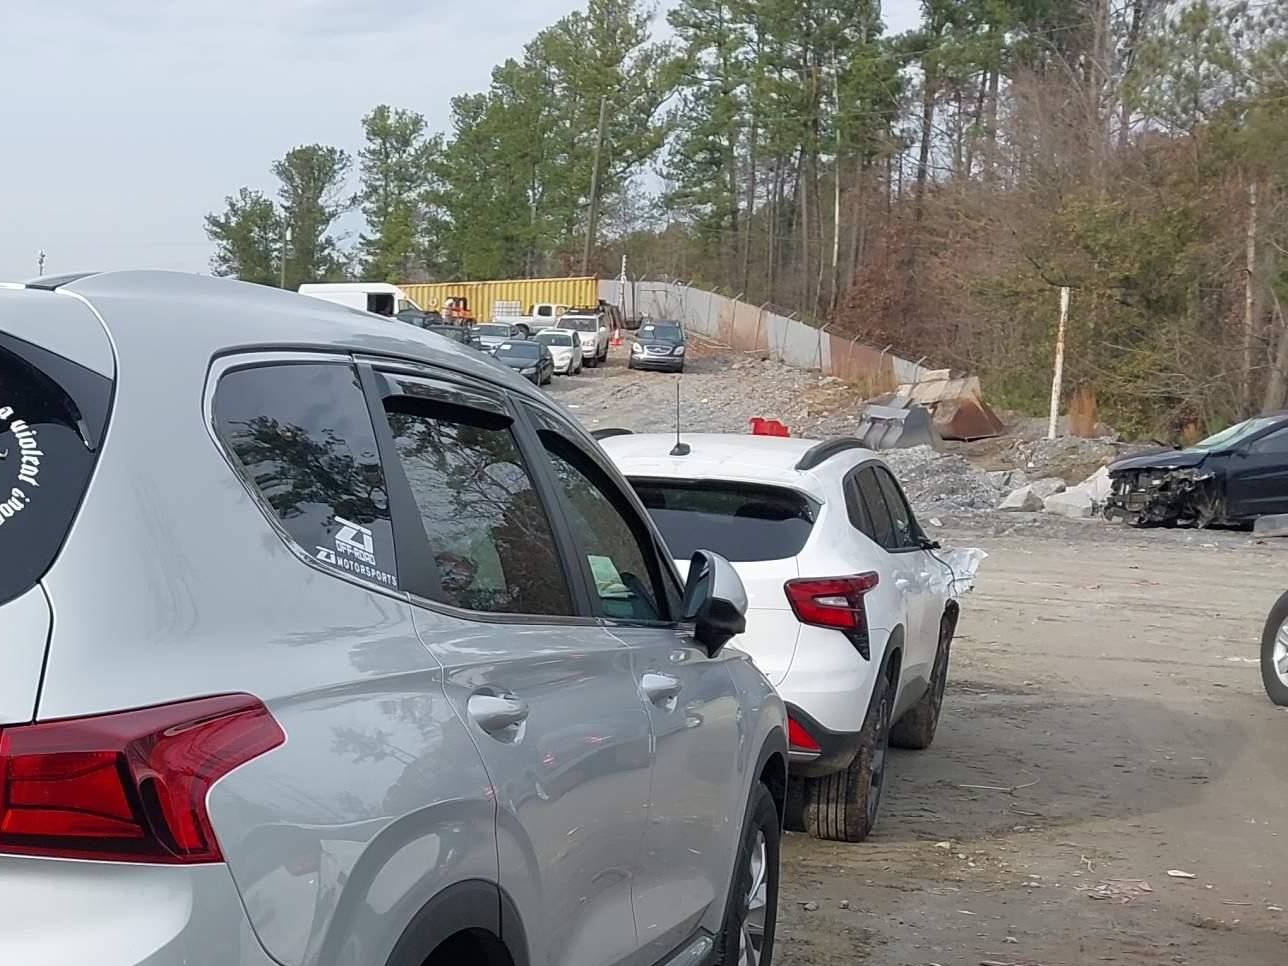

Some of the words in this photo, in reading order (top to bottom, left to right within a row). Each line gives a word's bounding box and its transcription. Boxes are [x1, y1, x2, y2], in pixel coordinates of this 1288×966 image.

[10, 419, 44, 486] violent
[335, 539, 376, 566] OFF-ROAD
[337, 556, 397, 587] MOTORSPORTS
